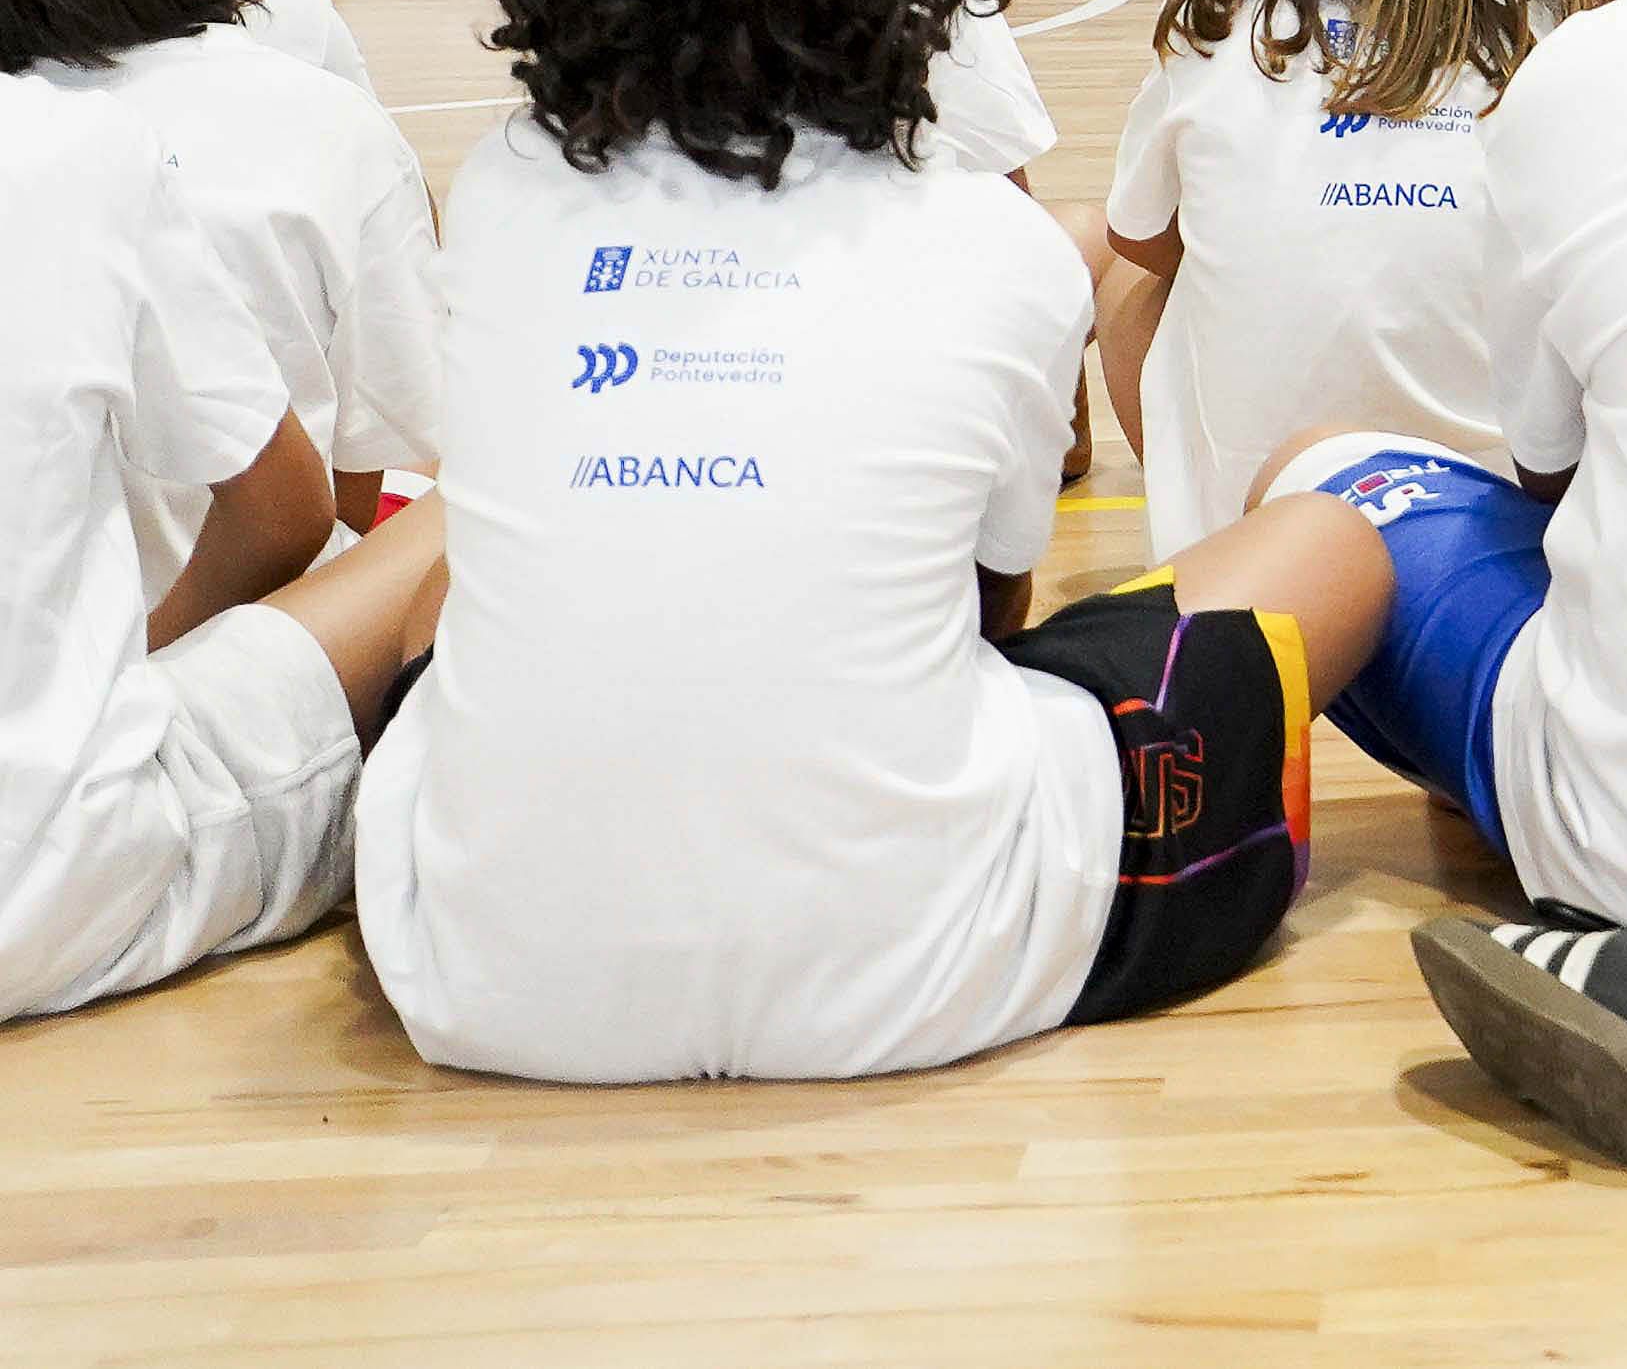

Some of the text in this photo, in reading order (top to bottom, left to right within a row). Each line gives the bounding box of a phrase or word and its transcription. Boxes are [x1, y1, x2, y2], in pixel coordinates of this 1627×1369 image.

[642, 248, 741, 267] XUNTA
[634, 270, 801, 289] DE GALICIA
[653, 348, 784, 367] Deputación
[650, 367, 783, 384] Pontevedra
